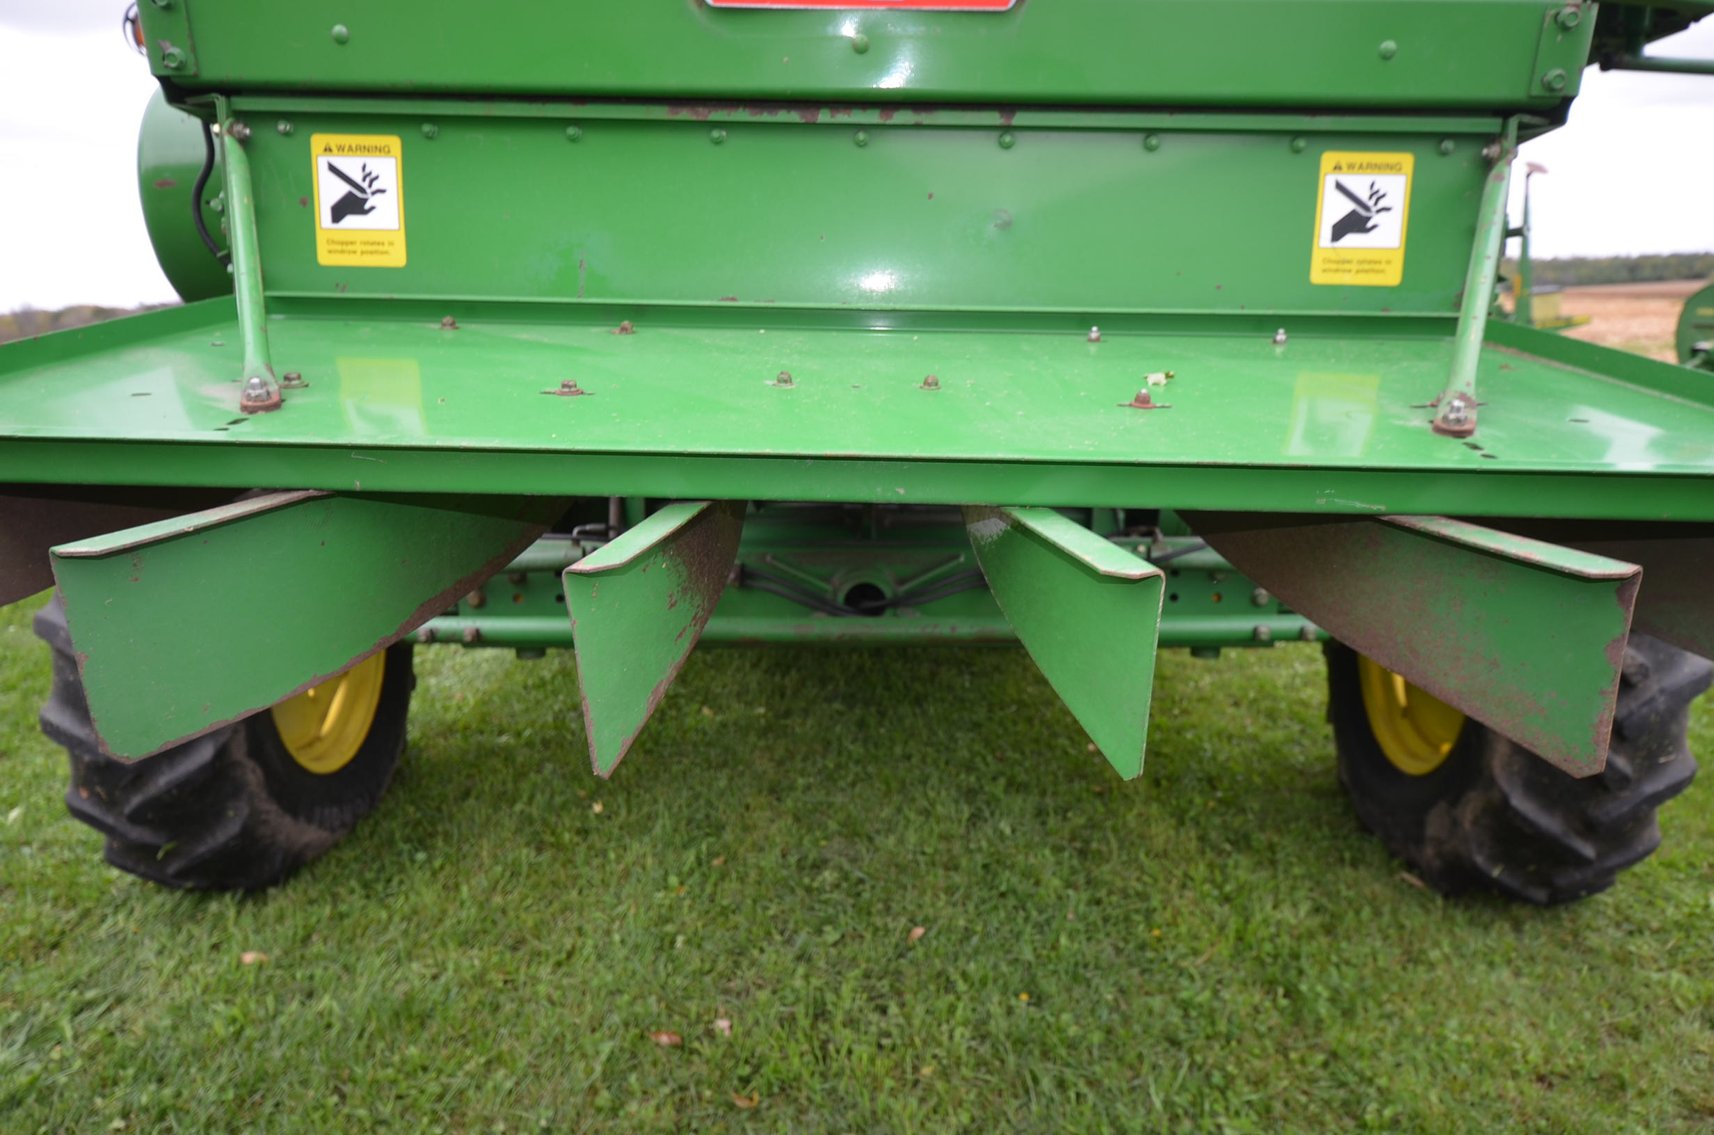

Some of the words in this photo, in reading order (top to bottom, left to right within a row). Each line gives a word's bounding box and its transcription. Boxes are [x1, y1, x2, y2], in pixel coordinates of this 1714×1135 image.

[335, 144, 391, 154] WARNING
[1346, 161, 1403, 172] WARNING
[326, 238, 357, 247] Chopper
